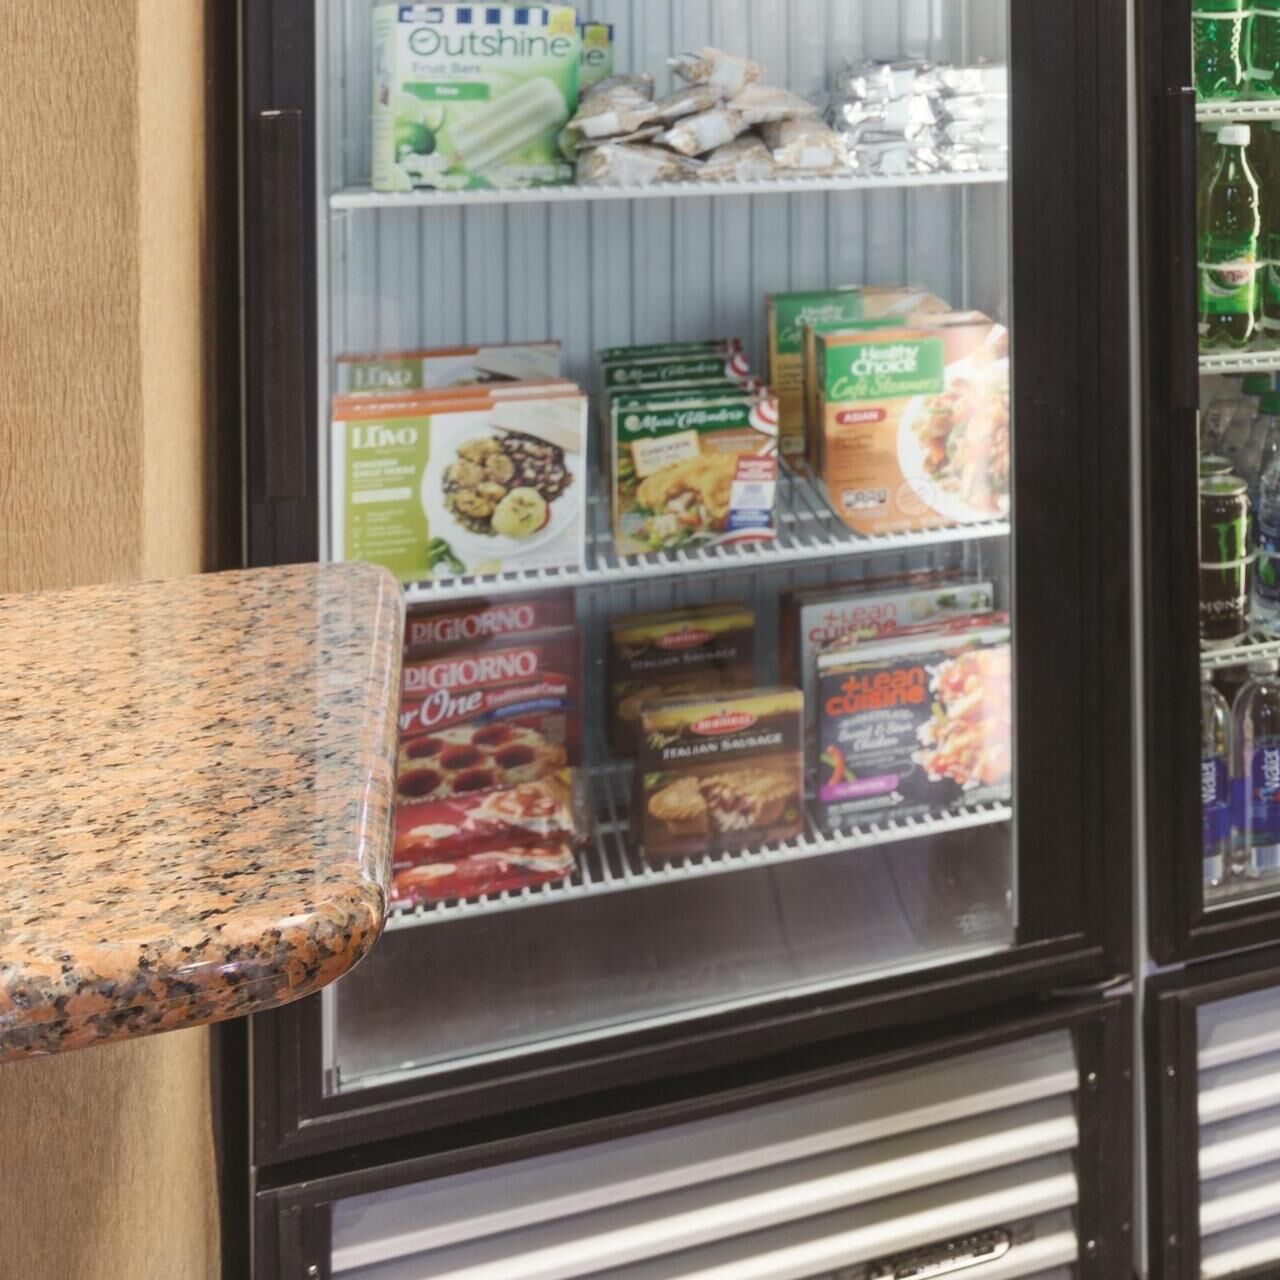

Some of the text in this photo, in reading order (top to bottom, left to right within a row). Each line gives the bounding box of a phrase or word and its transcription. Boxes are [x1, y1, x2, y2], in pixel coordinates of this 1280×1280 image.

[409, 27, 571, 56] Outshine
[452, 62, 480, 73] Bars
[861, 345, 919, 361] Healthy
[851, 359, 918, 377] Choice
[844, 411, 880, 423] ASIAN
[420, 688, 483, 726] One
[662, 732, 784, 761] ITALIAN SAUSAGE
[1264, 749, 1280, 792] water
